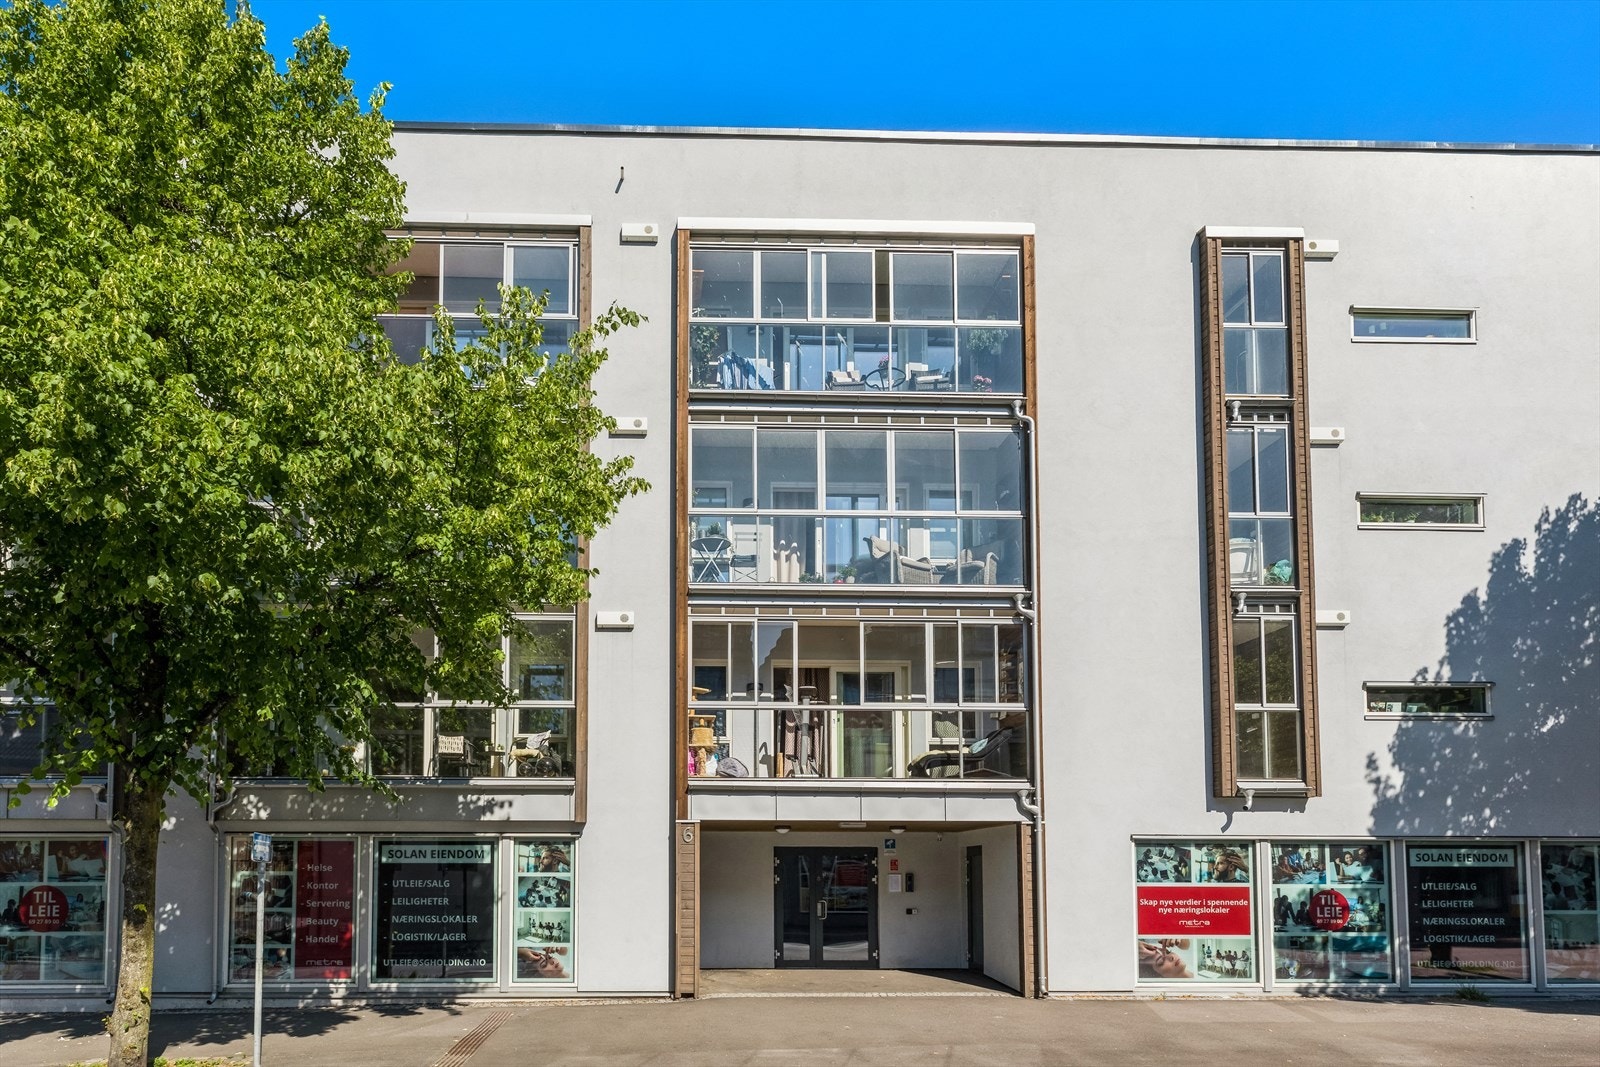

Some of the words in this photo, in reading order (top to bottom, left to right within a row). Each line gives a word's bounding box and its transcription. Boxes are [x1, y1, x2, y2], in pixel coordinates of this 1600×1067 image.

[683, 826, 693, 843] 6
[388, 849, 428, 860] SOLAN
[430, 849, 485, 860] EIENDOM
[1415, 853, 1453, 862] SOLAN
[1456, 853, 1508, 862] EIENDOM
[307, 864, 332, 872] Helse
[306, 882, 339, 890] Kontor
[392, 880, 450, 888] UTLEIE/SALG
[1421, 882, 1477, 890] UTLEIE/SALG
[33, 891, 56, 904] TIL
[1319, 894, 1339, 906] TIL
[306, 900, 350, 909] Servering
[392, 898, 449, 906] LEILIGHETER
[1207, 898, 1248, 906] spennende
[29, 904, 60, 917] LEIE
[1316, 906, 1342, 918] LEIE
[306, 918, 339, 926] Beauty
[392, 915, 478, 924] NÆRINGSLOKALER
[1422, 918, 1505, 926] NÆRINGSLOKALER
[306, 935, 338, 943] Handel
[392, 933, 466, 941] LOGISTIK/LAGER
[384, 958, 486, 967] UTLEIE@SGHOLDING.NO
[1417, 960, 1516, 968] UTLEIE@SGHOLDING.NO
